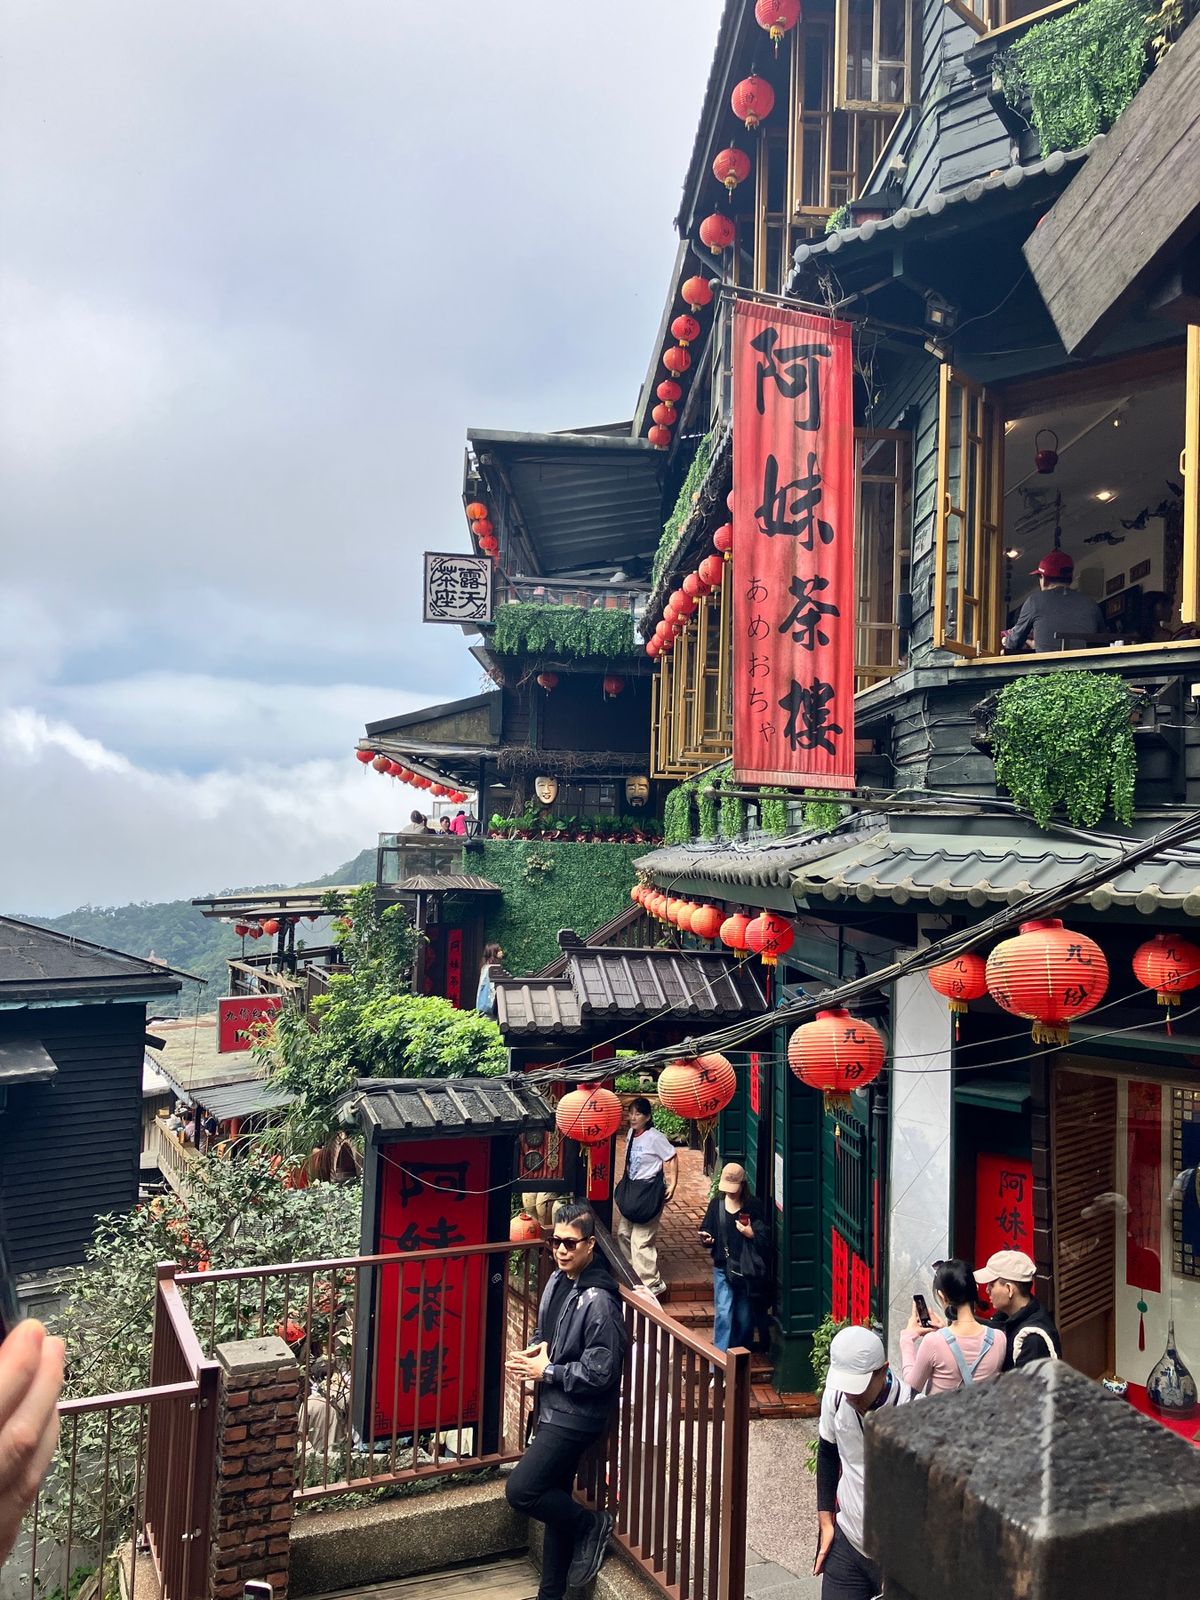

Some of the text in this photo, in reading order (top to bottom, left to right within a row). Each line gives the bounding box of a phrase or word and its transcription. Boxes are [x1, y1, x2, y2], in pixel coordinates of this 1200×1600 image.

[748, 326, 843, 756] 阿妹茶樓
[431, 565, 458, 608] 茶座
[458, 567, 487, 609] 露天
[746, 576, 775, 743] あめおちゃ
[765, 921, 780, 950] 九份
[953, 959, 968, 993] 九份
[1062, 943, 1093, 1007] 九份
[843, 1028, 866, 1080] 九份
[697, 1068, 721, 1112] 九份
[585, 1100, 604, 1137] 九份
[995, 1170, 1028, 1250] 阿妹
